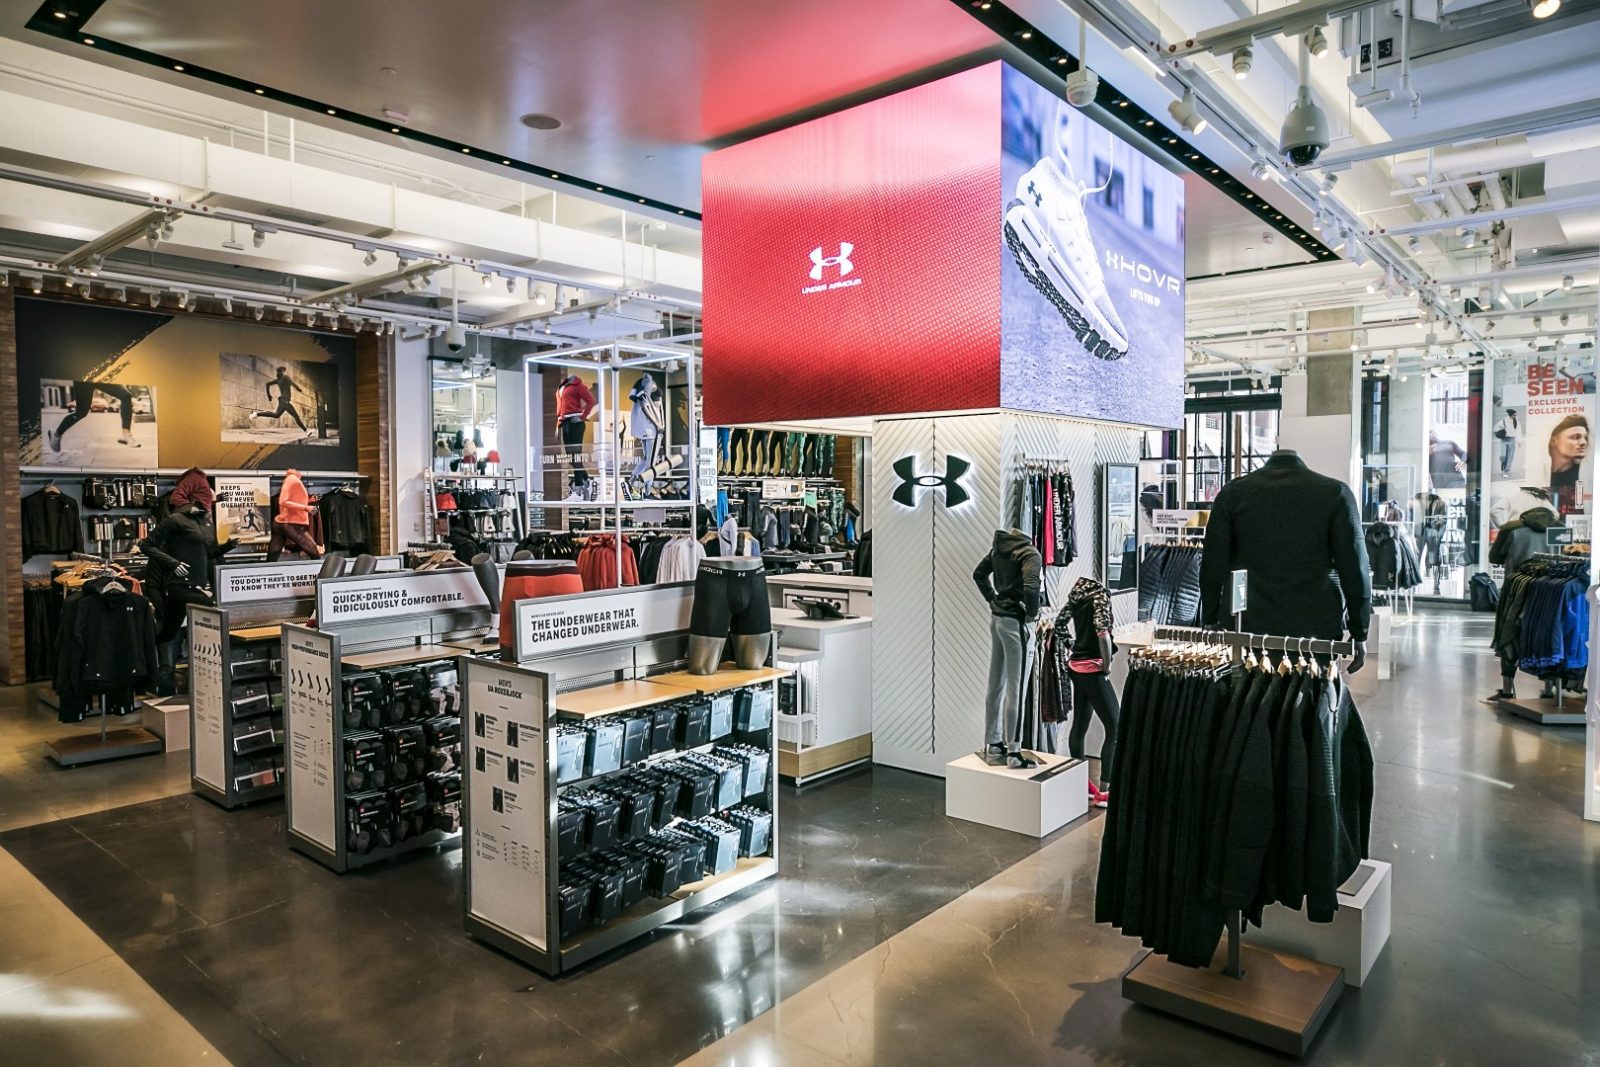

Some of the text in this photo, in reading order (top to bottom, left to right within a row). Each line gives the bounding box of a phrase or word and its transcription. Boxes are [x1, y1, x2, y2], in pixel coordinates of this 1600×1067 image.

[1361, 41, 1391, 60] F-3
[1120, 255, 1181, 296] HOVR
[1528, 363, 1554, 379] BE
[1528, 377, 1584, 396] SEEN
[1528, 397, 1578, 406] EXCLUSIVE
[1528, 406, 1584, 415] COLLECTION
[268, 575, 285, 583] HAVE
[333, 589, 400, 604] QUICK-DRYING
[401, 589, 408, 597] &
[333, 592, 464, 614] RIDICULOUSLY COMFORTABLE.
[531, 608, 635, 631] THE UNDERWEAR THAT
[531, 619, 639, 643] CHANGED UNDERWEAR.
